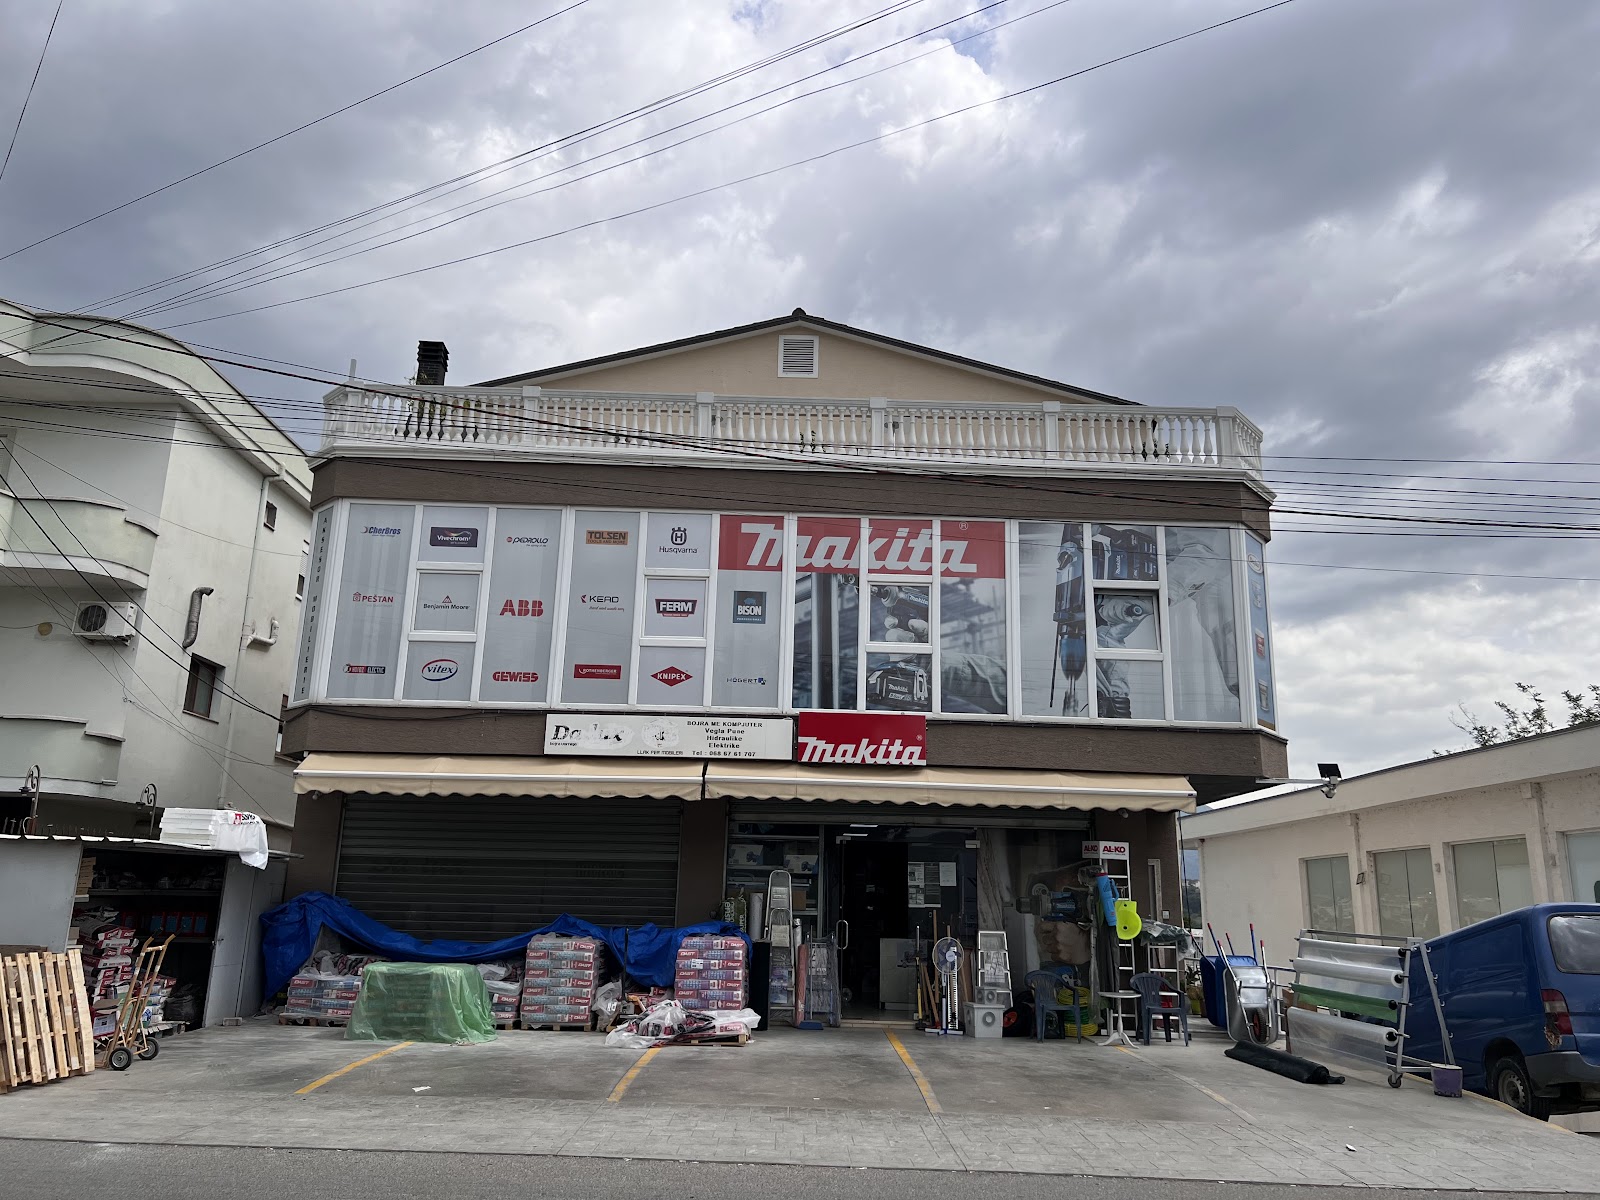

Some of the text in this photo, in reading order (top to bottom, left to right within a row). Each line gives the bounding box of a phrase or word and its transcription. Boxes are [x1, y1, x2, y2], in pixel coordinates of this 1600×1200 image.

[368, 527, 401, 535] CherBros
[588, 531, 626, 540] TOLSEN
[437, 534, 469, 542] Vivechrom
[659, 546, 697, 554] Husqvarna
[499, 599, 544, 617] ABB
[660, 601, 693, 612] FERM
[738, 605, 762, 616] BISON
[427, 665, 453, 674] vitex
[657, 672, 686, 681] KNIPEX
[1103, 845, 1126, 853] AL-KO
